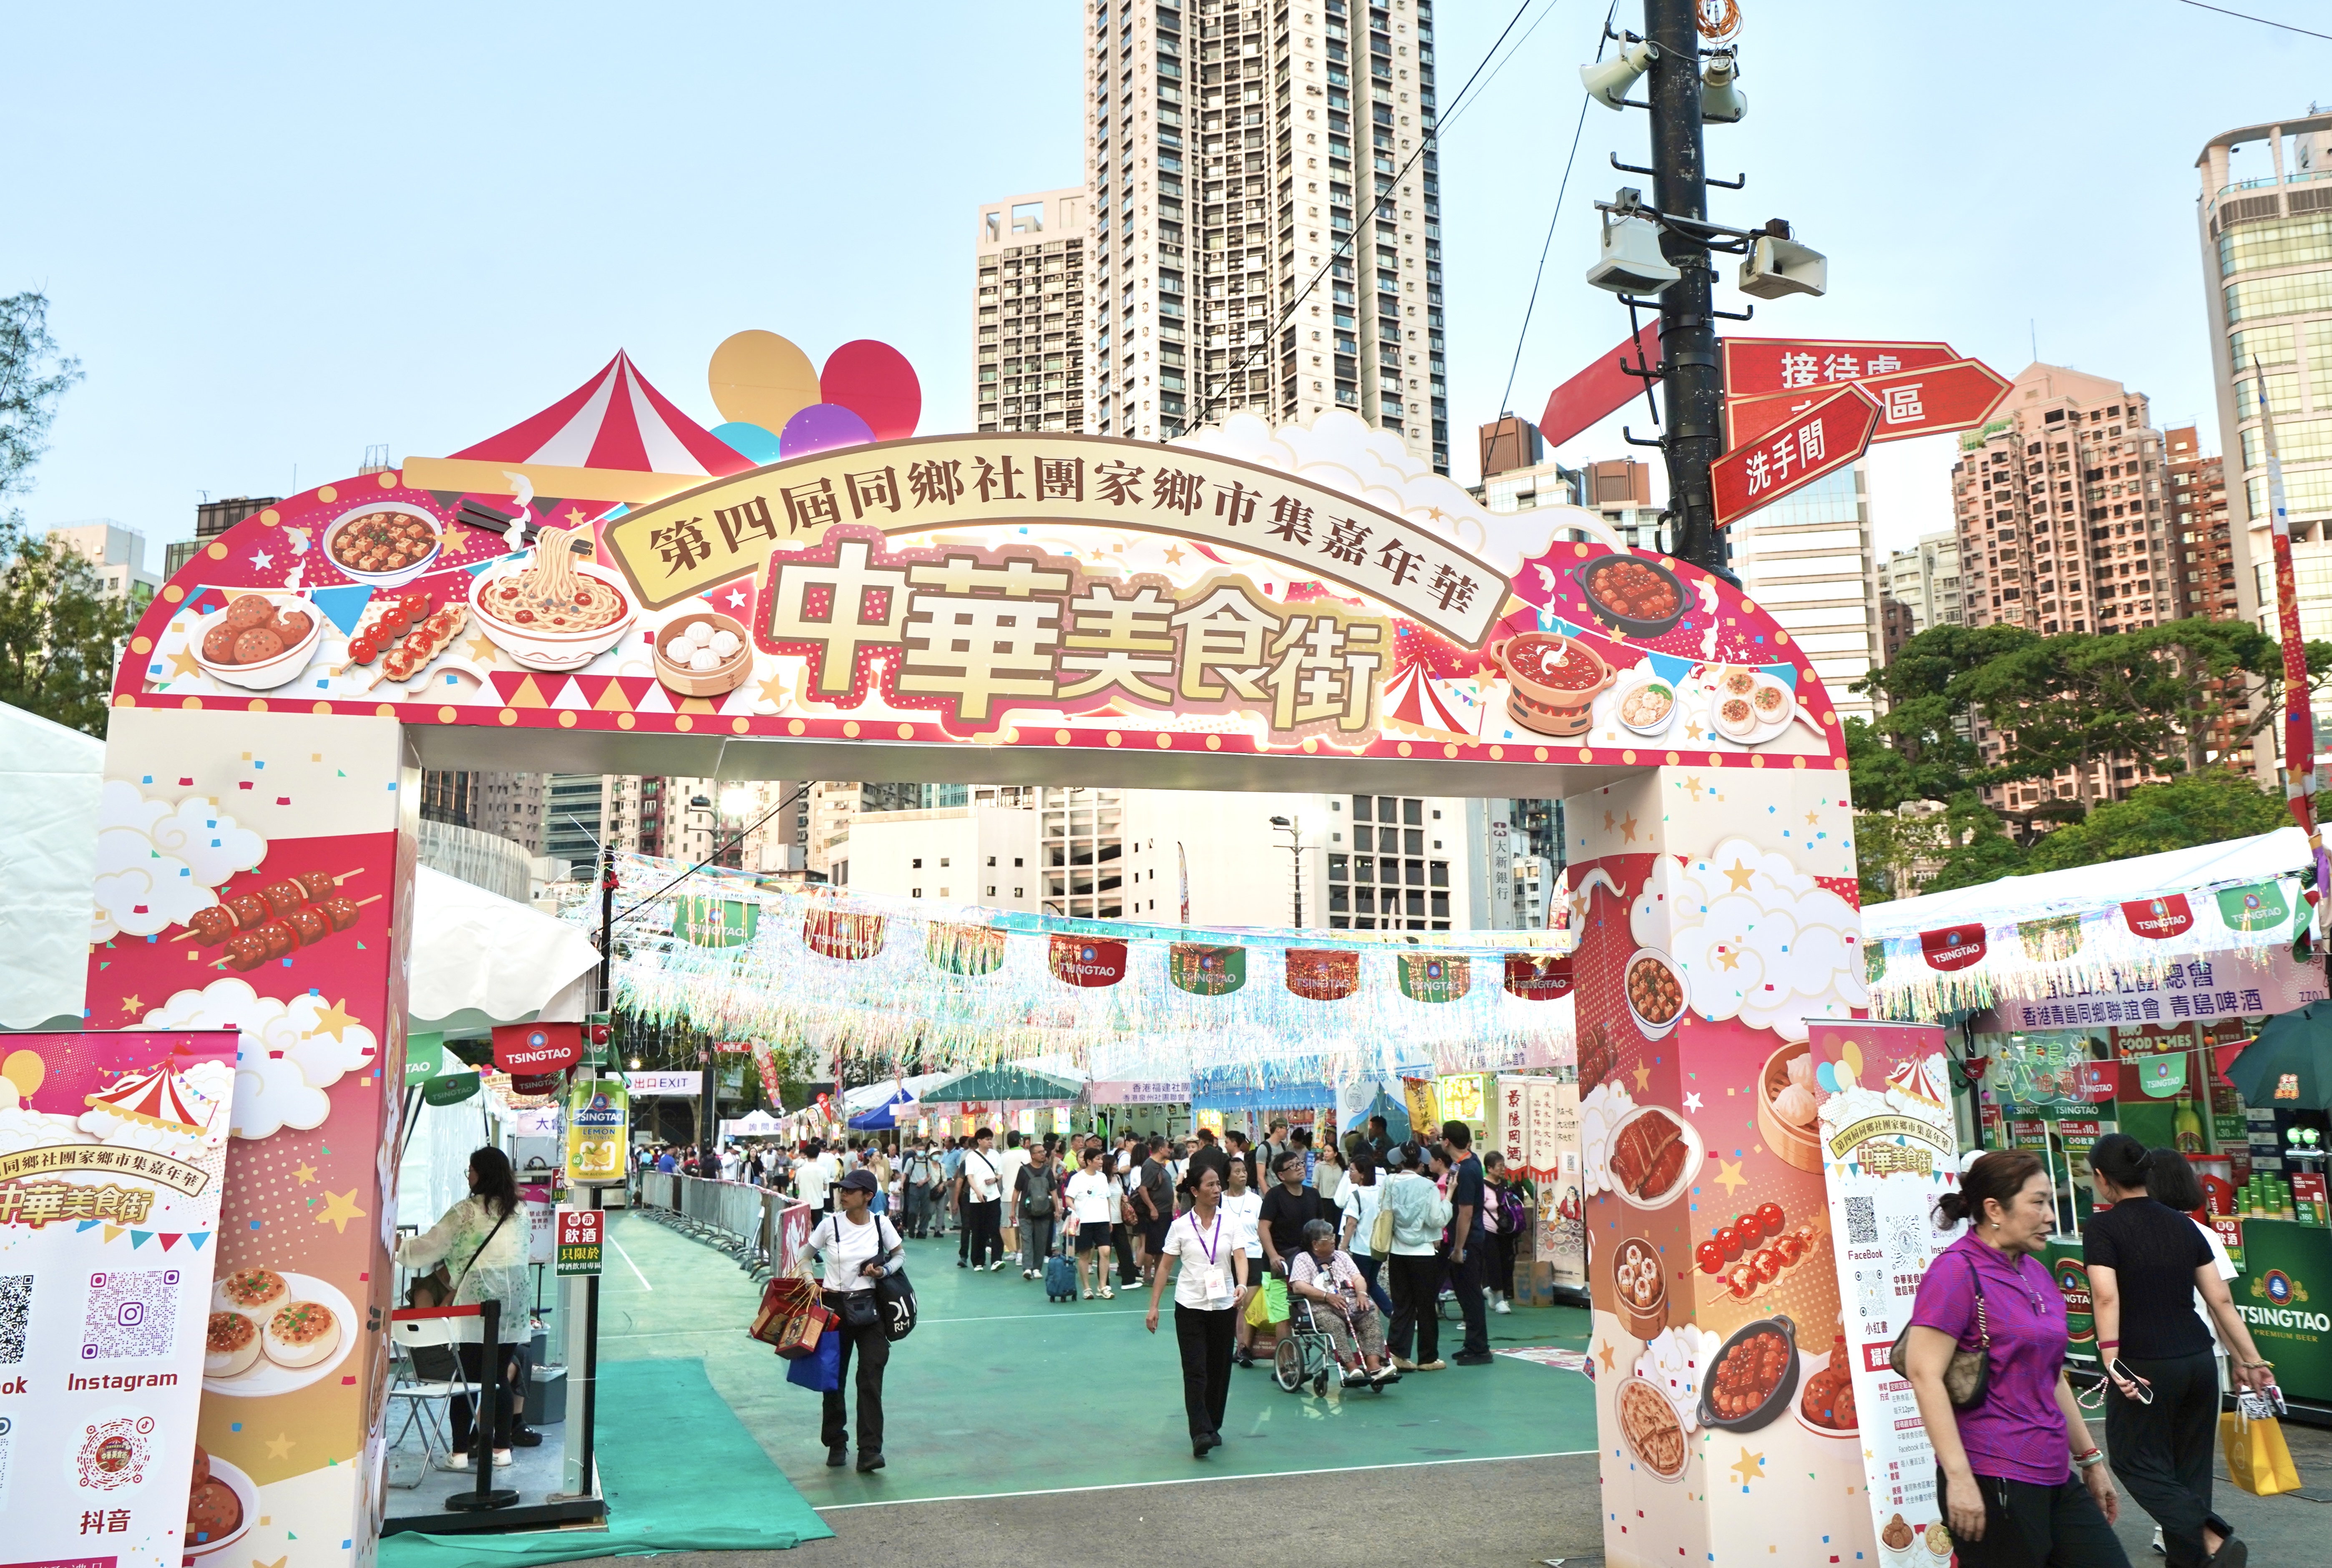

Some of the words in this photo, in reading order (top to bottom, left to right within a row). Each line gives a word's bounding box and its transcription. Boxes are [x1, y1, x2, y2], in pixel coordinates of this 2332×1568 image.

[1746, 417, 1825, 496] 洗手間
[650, 454, 1477, 614] 第四屆同鄉社團家鄉市集嘉年華
[770, 535, 1381, 731] 中華美食街
[1495, 840, 1508, 900] 大新銀行
[2136, 915, 2186, 930] TSINGTAO
[1933, 943, 1980, 964] TSINGTAO
[2023, 997, 2160, 1027] 香港青島同鄉聯誼會
[2169, 989, 2263, 1018] 青島啤酒
[506, 1047, 571, 1065] TSINGTAO
[634, 1078, 657, 1089] 出口
[660, 1077, 688, 1088] EXIT
[2037, 1070, 2076, 1096] 啤酒
[2079, 1084, 2113, 1092] TSINGTAO
[2146, 1076, 2180, 1088] TSINGTAO
[432, 1086, 473, 1101] TSINGTAO
[2054, 1106, 2099, 1115] TSINGTAO
[1505, 1090, 1521, 1162] 景陽岡酒
[1835, 1119, 1950, 1152] 第四屆同鄉社團家鄉市集嘉年華
[0, 1150, 200, 1187] 同鄉社團家鄉市集嘉年華
[1859, 1143, 1932, 1176] 中華美食街
[0, 1184, 153, 1225] 中華美食街
[565, 1228, 597, 1243] 飲酒
[561, 1246, 599, 1261] 只限於
[1848, 1249, 1883, 1260] FaceBook
[558, 1261, 601, 1271] 啤酒飲用專區
[1865, 1321, 1888, 1335] 小紅書
[2236, 1305, 2330, 1332] TSINGTAO
[2254, 1329, 2294, 1340] PREMIUM
[2296, 1333, 2318, 1342] BEER
[68, 1373, 178, 1392] Instagram
[1899, 1443, 1919, 1453] Facebook
[80, 1509, 131, 1535] 抖音
